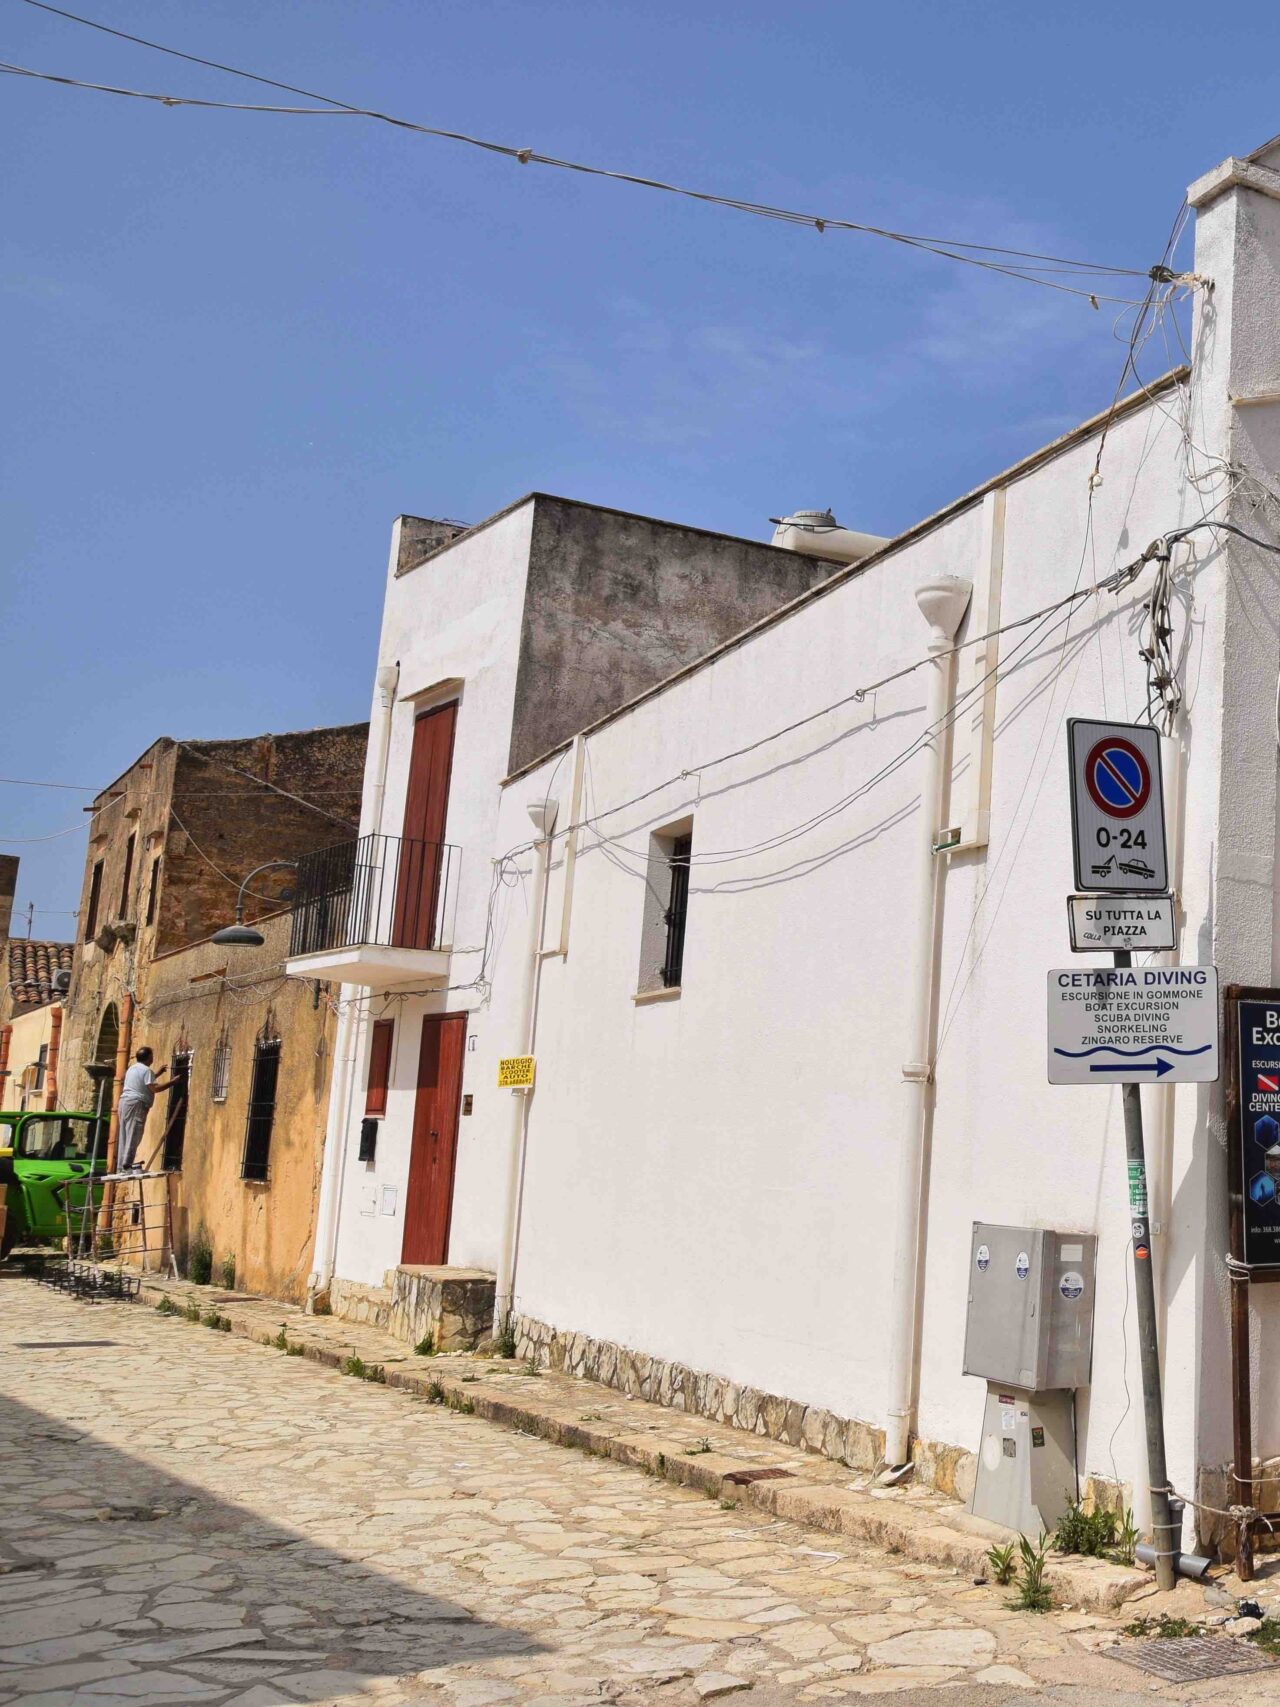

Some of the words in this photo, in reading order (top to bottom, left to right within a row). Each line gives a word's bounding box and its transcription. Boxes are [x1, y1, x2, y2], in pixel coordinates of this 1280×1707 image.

[1096, 827, 1148, 850] 0-24
[1085, 910, 1102, 921] SU
[1105, 910, 1144, 921] TUTTA
[1147, 910, 1162, 920] LA
[1103, 925, 1147, 936] PIAZZA
[1058, 972, 1138, 988] CETARIA
[1144, 971, 1208, 986] DIVING
[1061, 991, 1131, 1001] ESCURSIONE
[1133, 991, 1143, 1000] IN
[1146, 990, 1204, 1000] GOMMONE
[1085, 1003, 1114, 1012] BOAT
[1116, 1001, 1179, 1011] EXCURSION
[1094, 1014, 1131, 1023] SCUBA
[1133, 1012, 1170, 1022] DIVING
[1097, 1024, 1168, 1034] SNORKELING
[1081, 1035, 1130, 1045] ZINGARO
[1132, 1034, 1183, 1044] RESERVE
